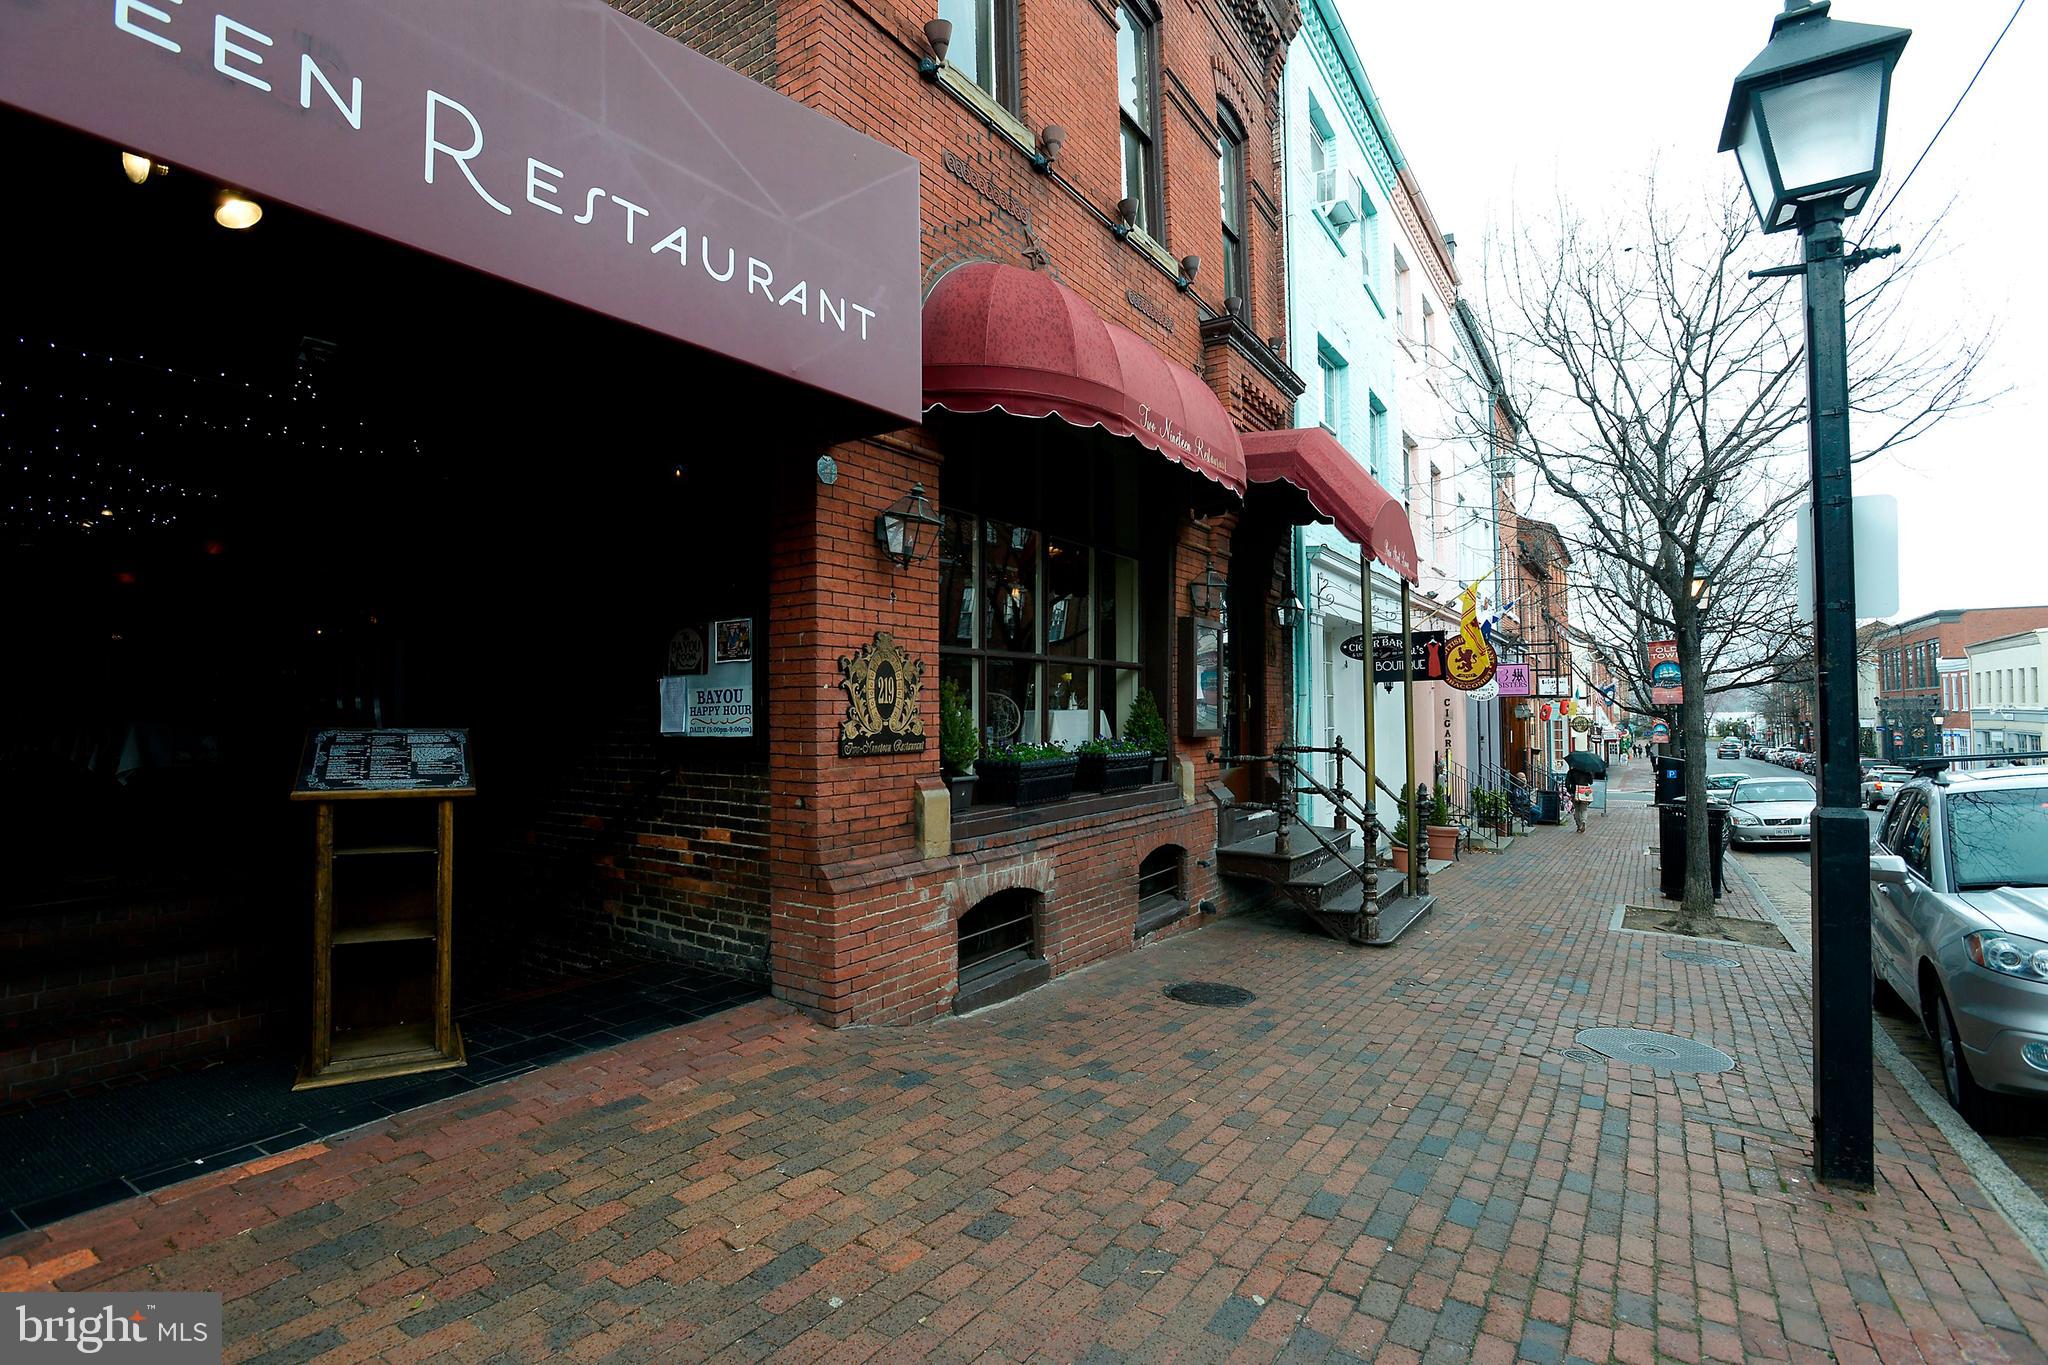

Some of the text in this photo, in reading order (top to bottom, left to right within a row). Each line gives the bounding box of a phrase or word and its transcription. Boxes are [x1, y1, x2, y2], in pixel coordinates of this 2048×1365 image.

[424, 89, 877, 341] RESTAURANT
[1348, 638, 1403, 652] CIGR BAR
[1655, 645, 1677, 653] OLD
[878, 676, 895, 704] 219
[1498, 681, 1528, 689] SISTERS
[696, 688, 744, 705] BAYOU
[689, 704, 752, 717] HAPPY HOUR
